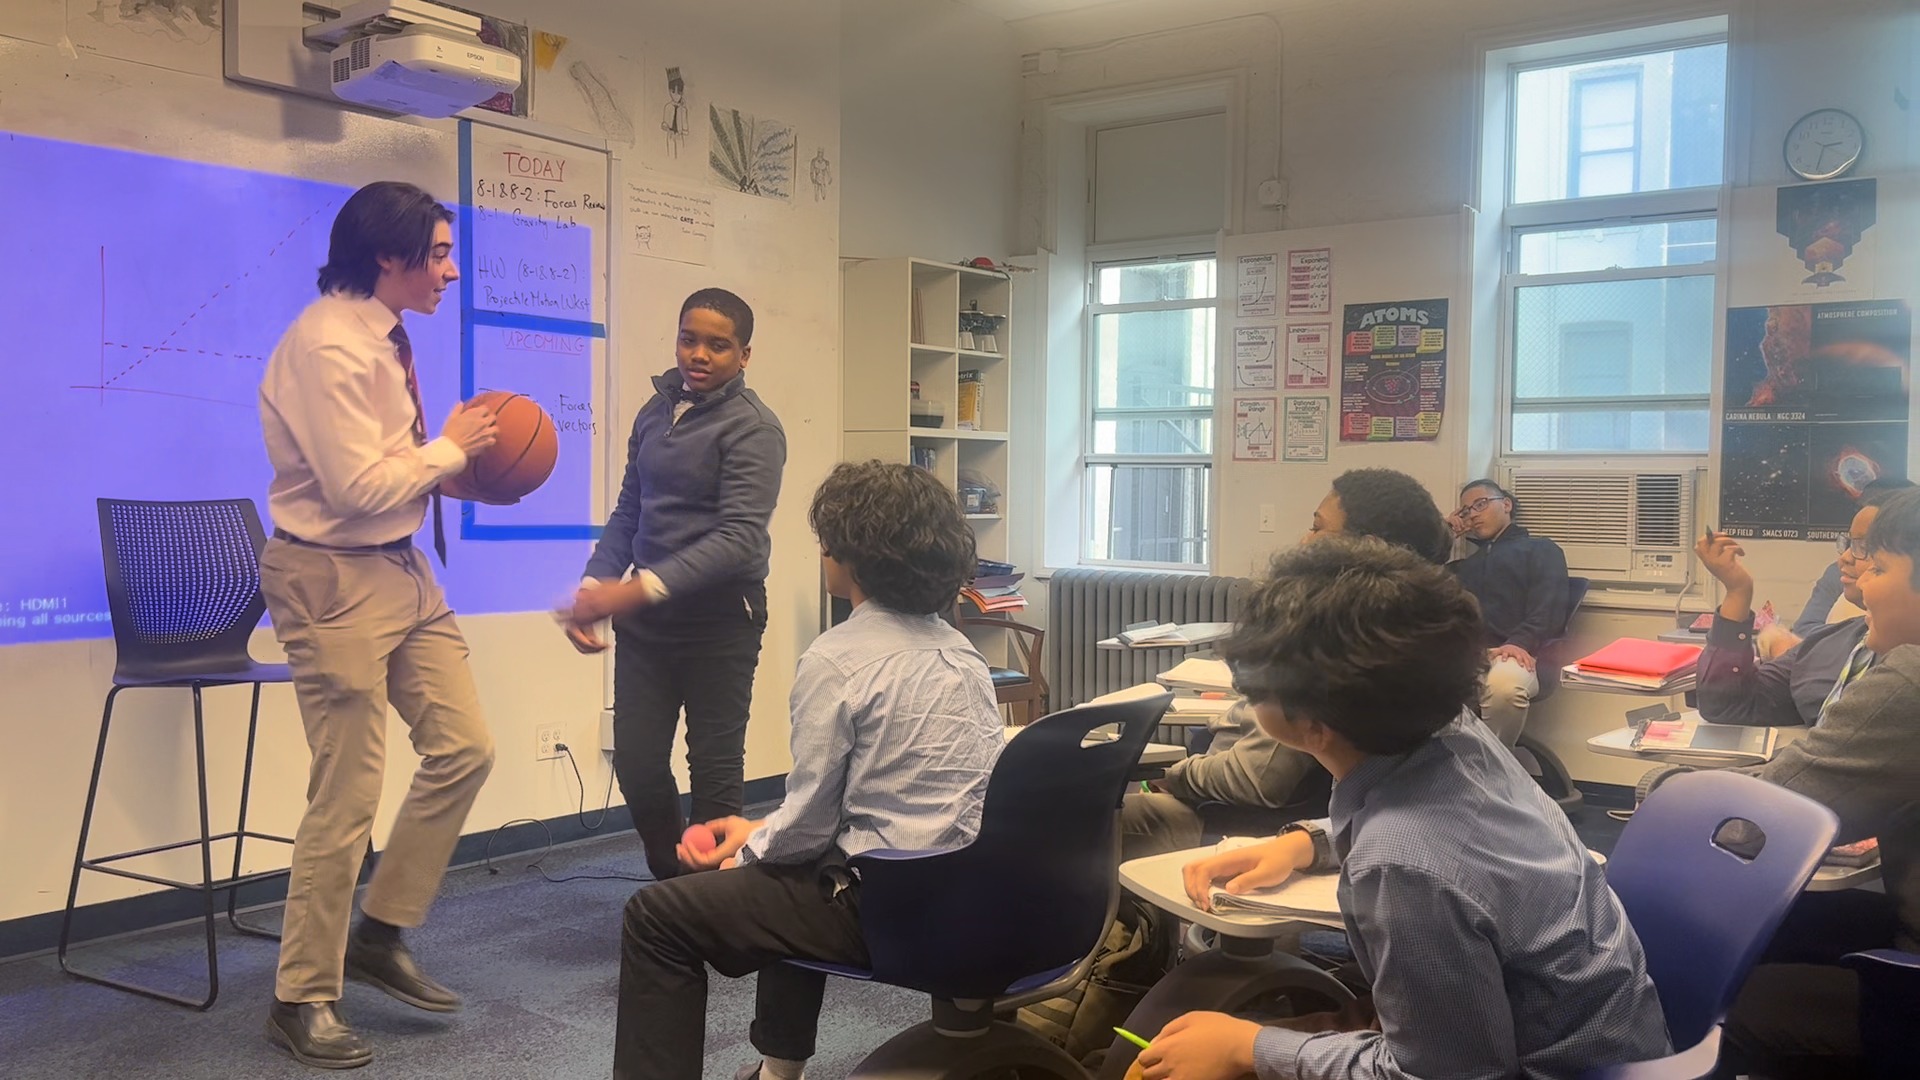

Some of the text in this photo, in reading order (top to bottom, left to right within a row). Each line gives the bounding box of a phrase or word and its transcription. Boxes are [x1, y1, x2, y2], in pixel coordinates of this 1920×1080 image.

[467, 52, 485, 61] EPSON
[503, 152, 565, 180] TODAY
[544, 190, 577, 209] Forces
[513, 208, 549, 239] Gravity
[556, 215, 576, 230] Lab
[479, 255, 506, 280] HW
[1240, 255, 1272, 263] Exponential
[1359, 307, 1429, 329] ATOMS
[1817, 308, 1898, 319] ATMOSPHERE COMPOSITION
[502, 330, 584, 352] UPCOMING
[560, 394, 593, 415] Forces
[1725, 412, 1806, 421] CARINA NEBULA NGC 3324
[1721, 528, 1736, 537] DEEP
[1737, 528, 1754, 537] FIELD
[1762, 529, 1782, 538] SMACS
[1783, 529, 1799, 538] 0723
[20, 597, 67, 612] HDMI1
[32, 613, 48, 626] all
[54, 612, 112, 624] sources
